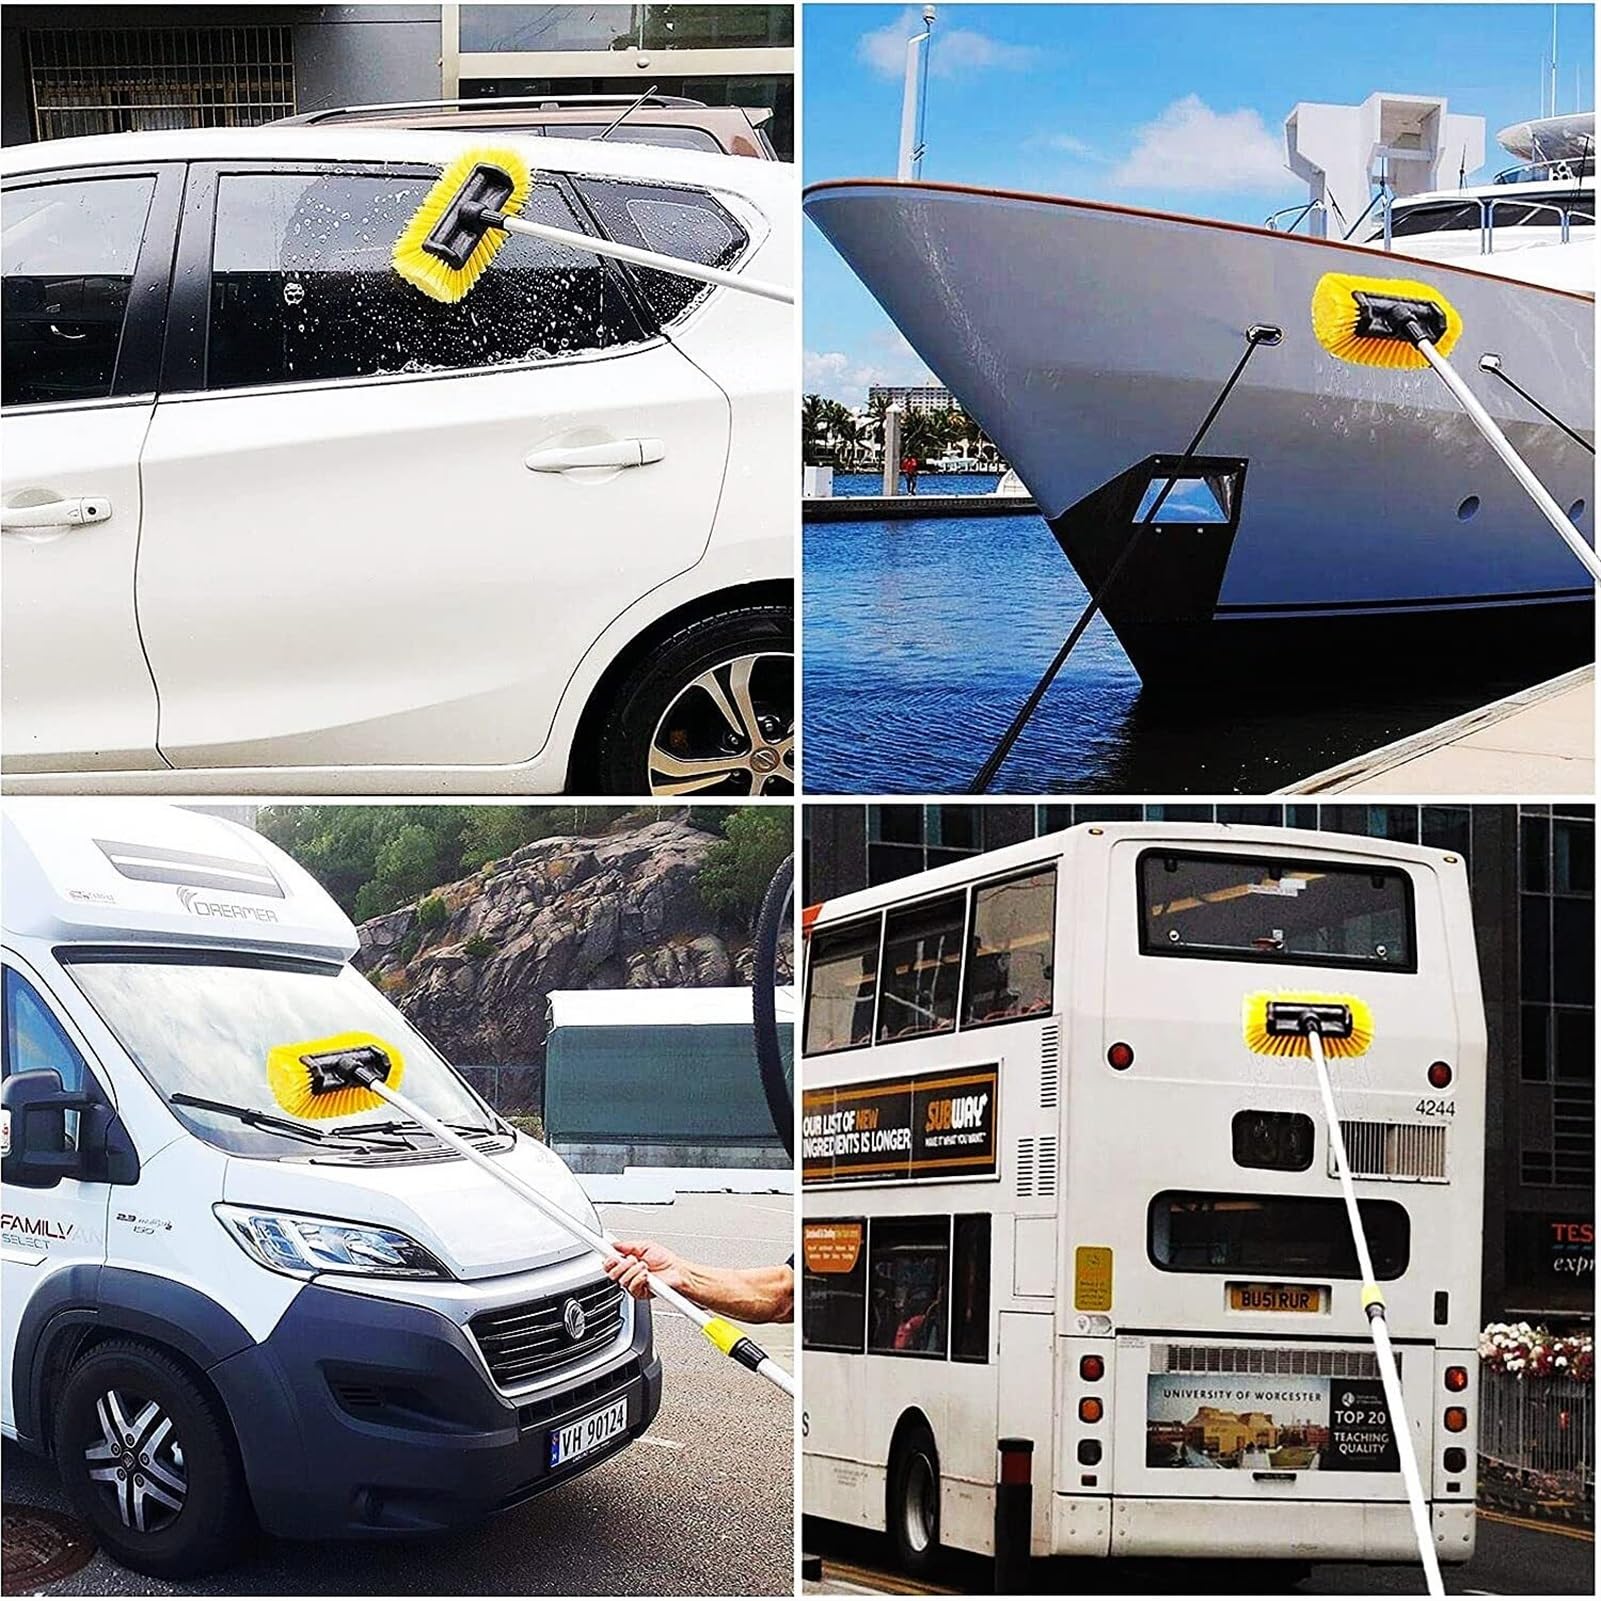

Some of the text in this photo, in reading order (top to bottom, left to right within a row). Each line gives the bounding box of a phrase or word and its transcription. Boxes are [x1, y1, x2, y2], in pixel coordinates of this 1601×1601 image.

[194, 902, 279, 923] DREAMER
[925, 1093, 988, 1132] SUBWAY
[1415, 1099, 1456, 1117] 4244
[823, 1111, 843, 1135] LIST
[843, 1110, 856, 1133] OF
[856, 1108, 879, 1130] NEW
[861, 1131, 870, 1153] IS
[871, 1128, 911, 1152] LONGER
[2, 1232, 50, 1249] SELECT
[1552, 1223, 1593, 1243] TES
[1279, 1292, 1310, 1309] RUR
[1163, 1389, 1322, 1402] UNIVERSITY OF WORCESTER
[802, 1411, 810, 1437] S
[1334, 1410, 1386, 1425] TOP 20
[562, 1404, 624, 1456] VH 90124
[1333, 1432, 1390, 1443] TEACHING
[1339, 1443, 1386, 1456] QUALITY
